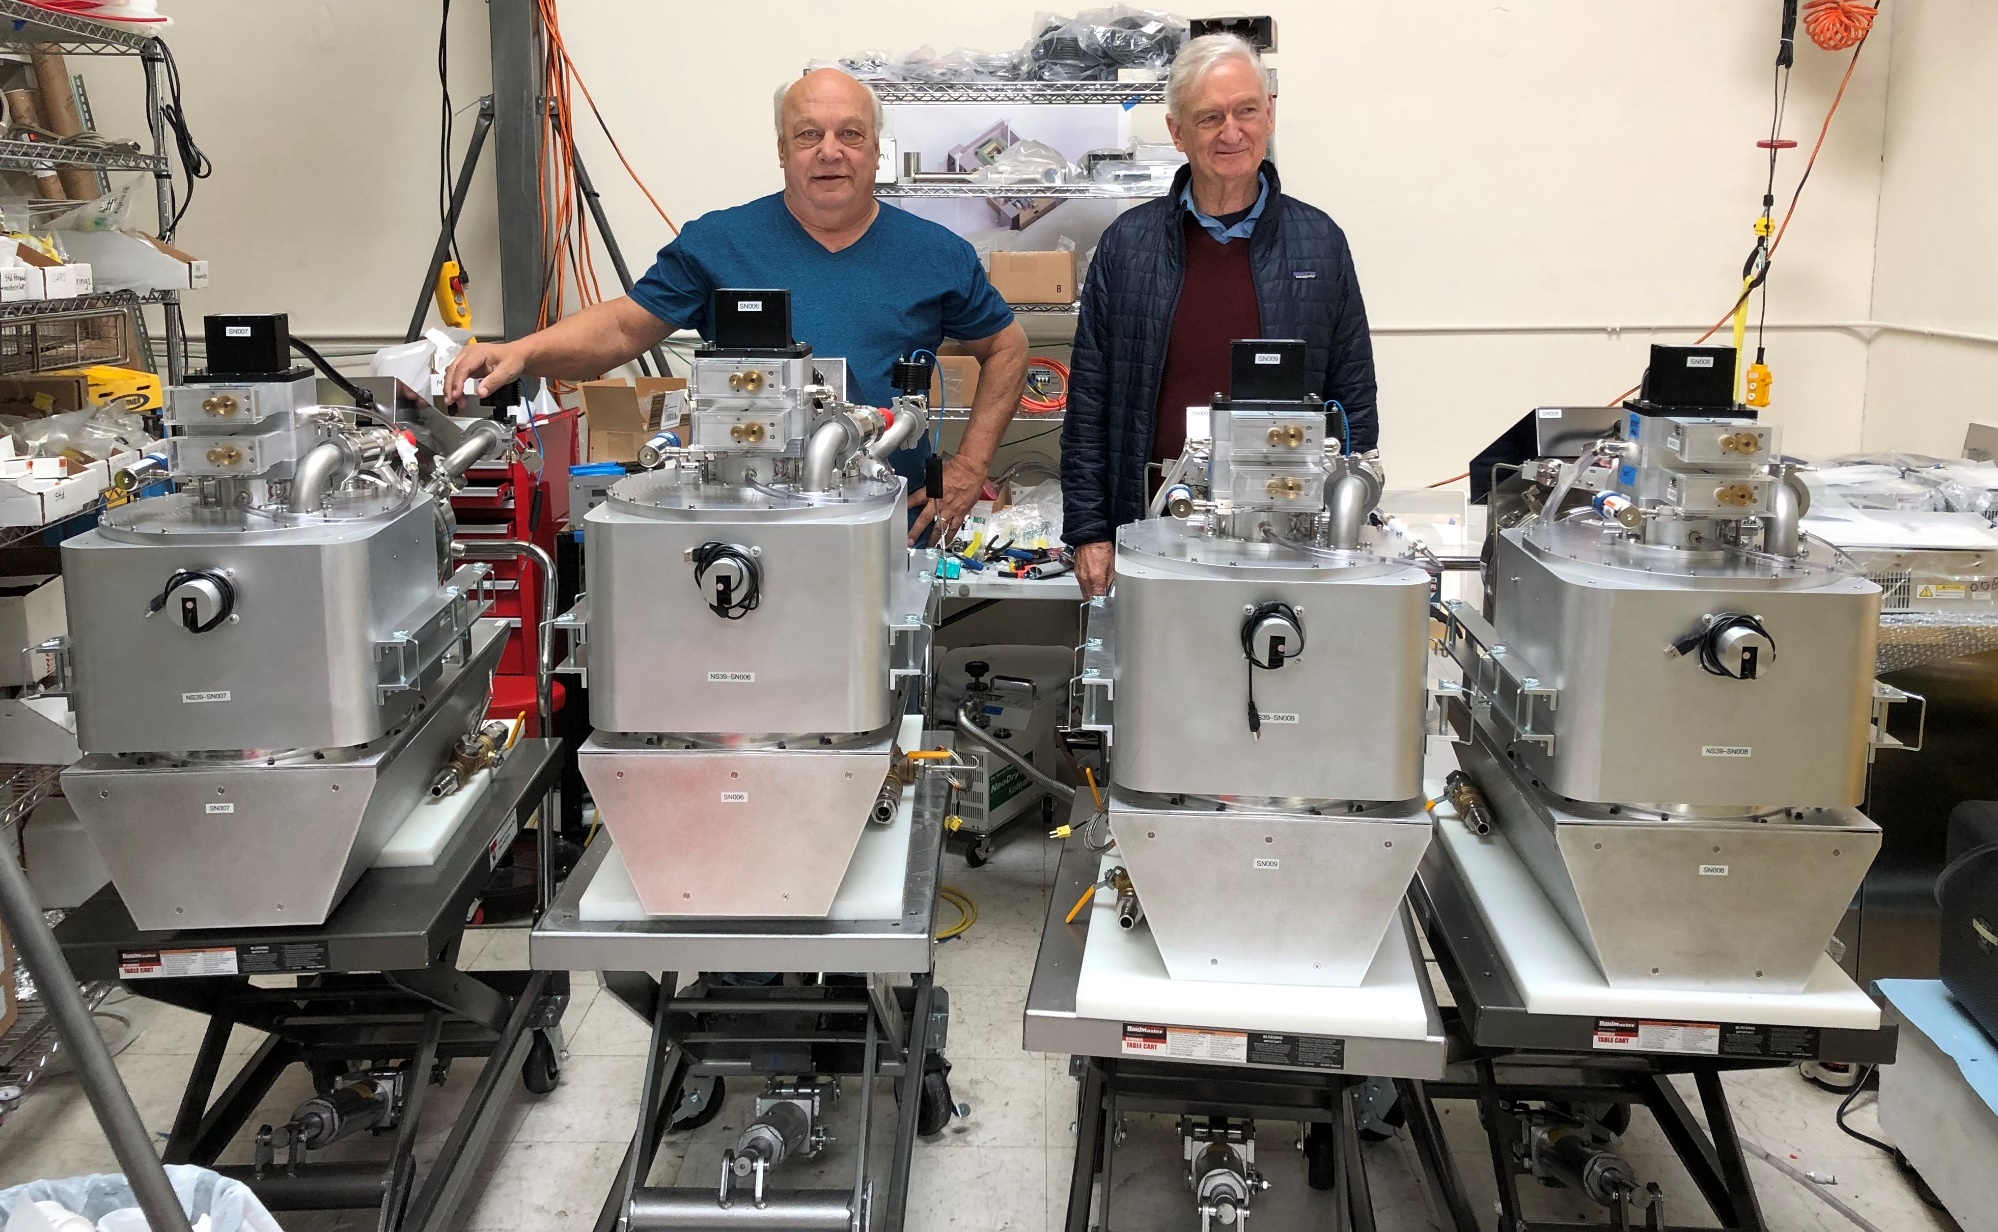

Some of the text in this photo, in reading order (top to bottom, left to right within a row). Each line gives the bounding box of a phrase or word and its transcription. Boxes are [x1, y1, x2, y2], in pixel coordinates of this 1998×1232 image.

[1056, 284, 1062, 294] B
[710, 673, 752, 681] NS39-SN006
[185, 692, 228, 701] NS39-SN007
[990, 771, 1019, 794] NeoDry
[723, 793, 745, 801] SN006
[1126, 1041, 1142, 1049] TABLE
